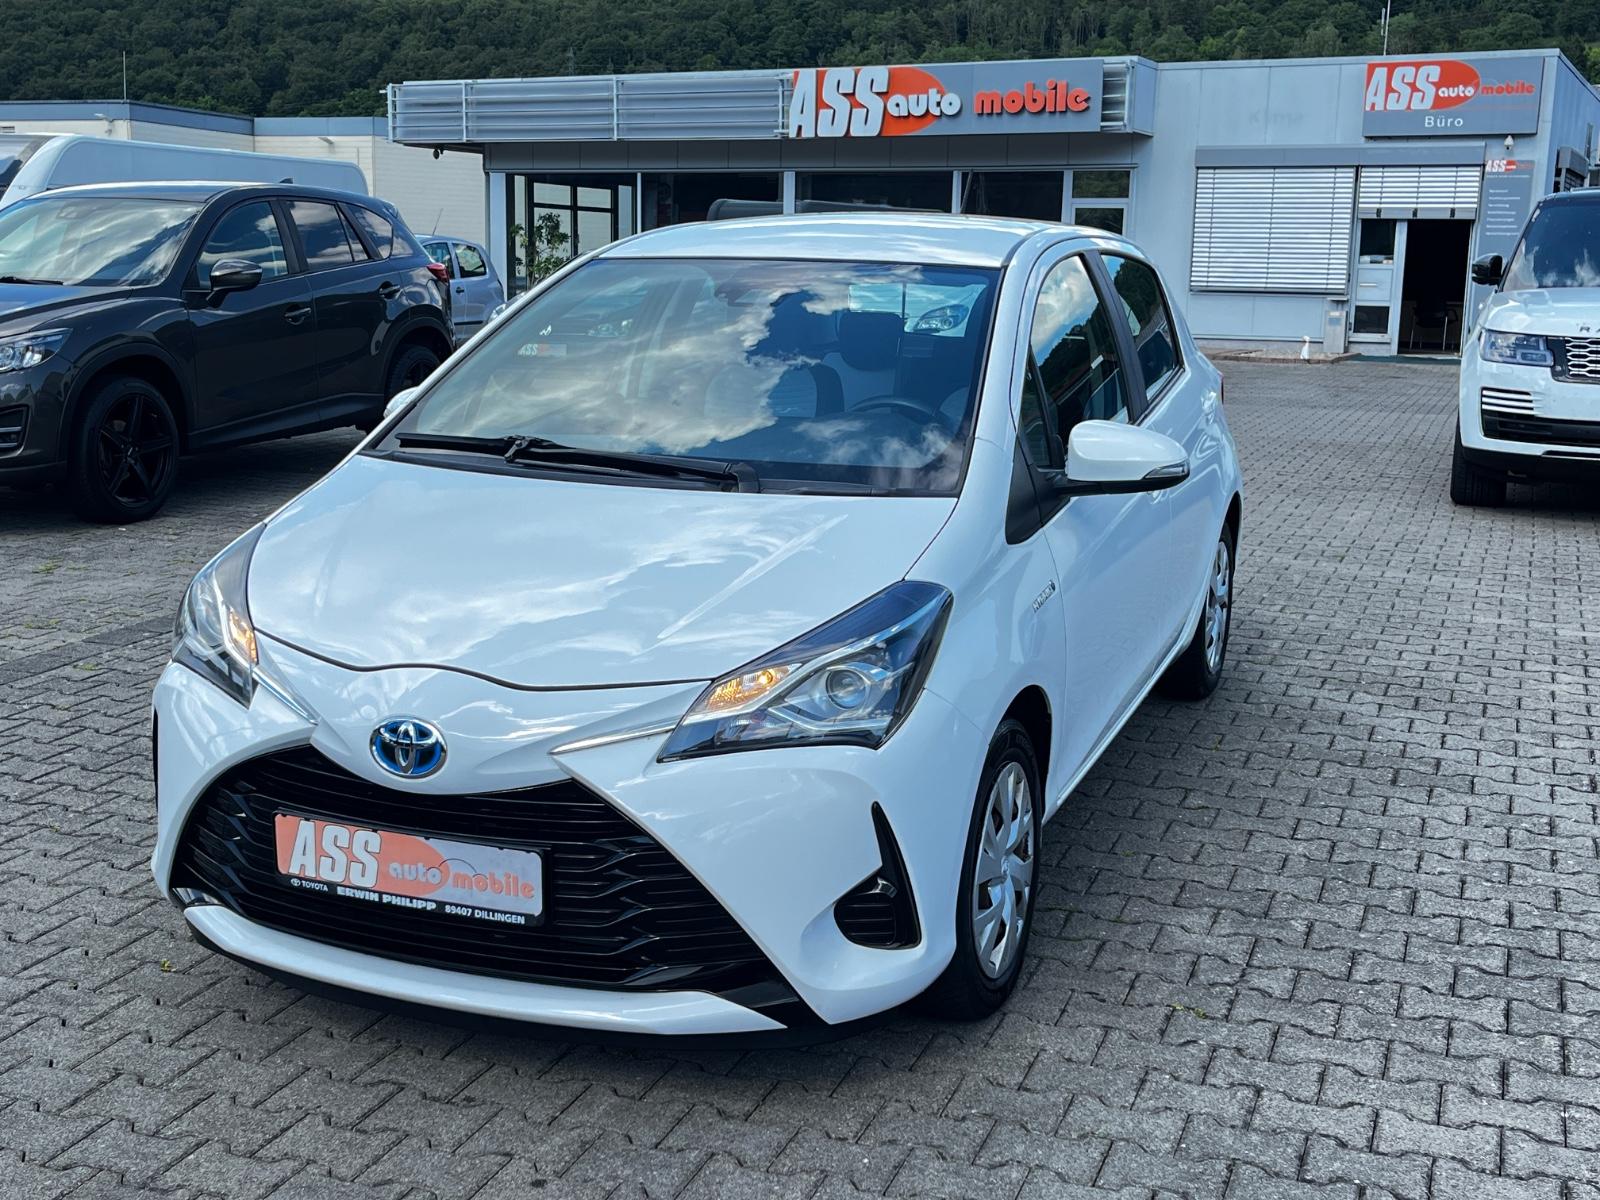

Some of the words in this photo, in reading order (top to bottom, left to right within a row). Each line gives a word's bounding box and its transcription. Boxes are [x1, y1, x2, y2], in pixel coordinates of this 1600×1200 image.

[789, 67, 889, 138] ASS
[887, 88, 962, 117] auto
[973, 80, 1091, 115] mobile
[1365, 65, 1441, 111] ASS
[1438, 84, 1476, 98] auto
[1480, 80, 1536, 96] mobile
[1424, 116, 1464, 128] Büro
[1486, 160, 1507, 172] ASS
[288, 820, 382, 889] ASS
[388, 861, 443, 885] auto
[452, 871, 535, 900] mobile
[301, 880, 329, 892] TOYOTA
[336, 886, 380, 902] ERWIN
[382, 894, 437, 911] PHILIPP
[445, 904, 473, 917] 89407
[474, 909, 526, 925] DILLINGEN
